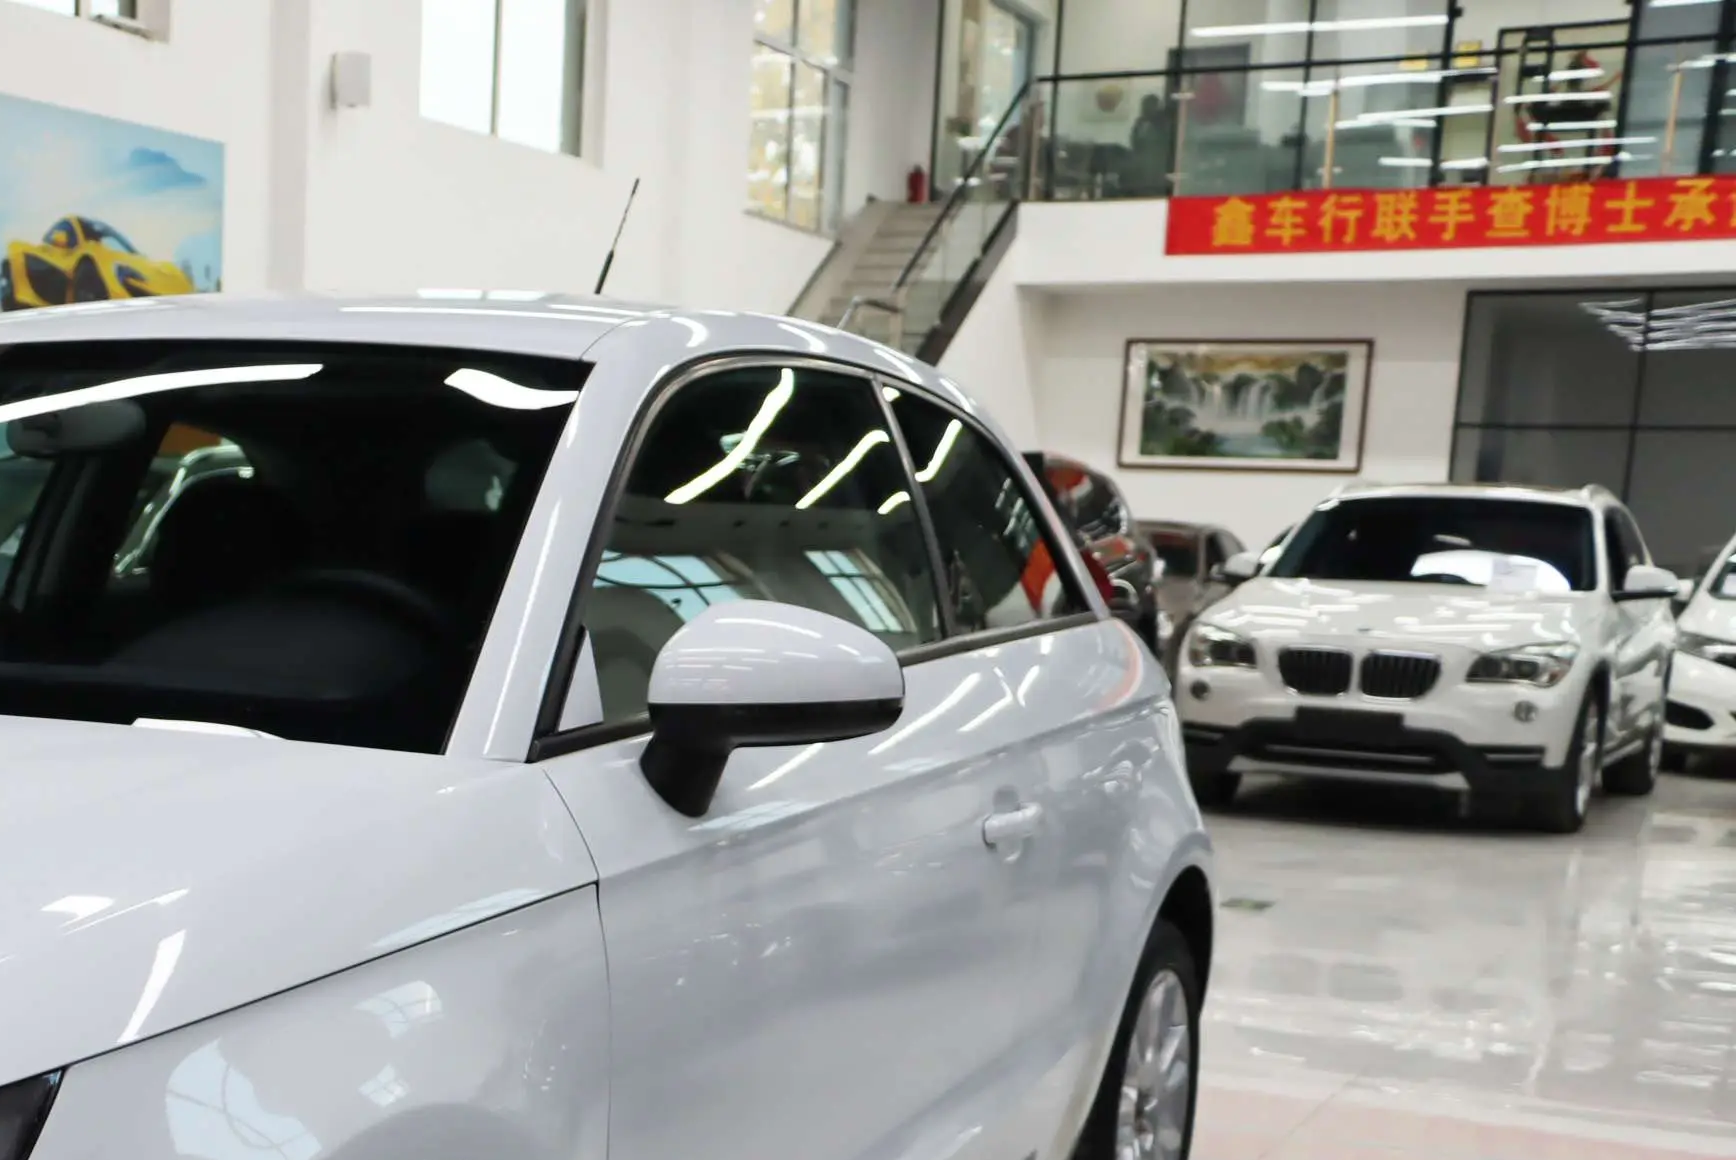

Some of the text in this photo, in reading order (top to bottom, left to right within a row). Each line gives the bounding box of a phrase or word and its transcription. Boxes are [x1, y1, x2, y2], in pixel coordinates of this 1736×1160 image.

[1212, 178, 1736, 247] 鑫车行联手查博士承
